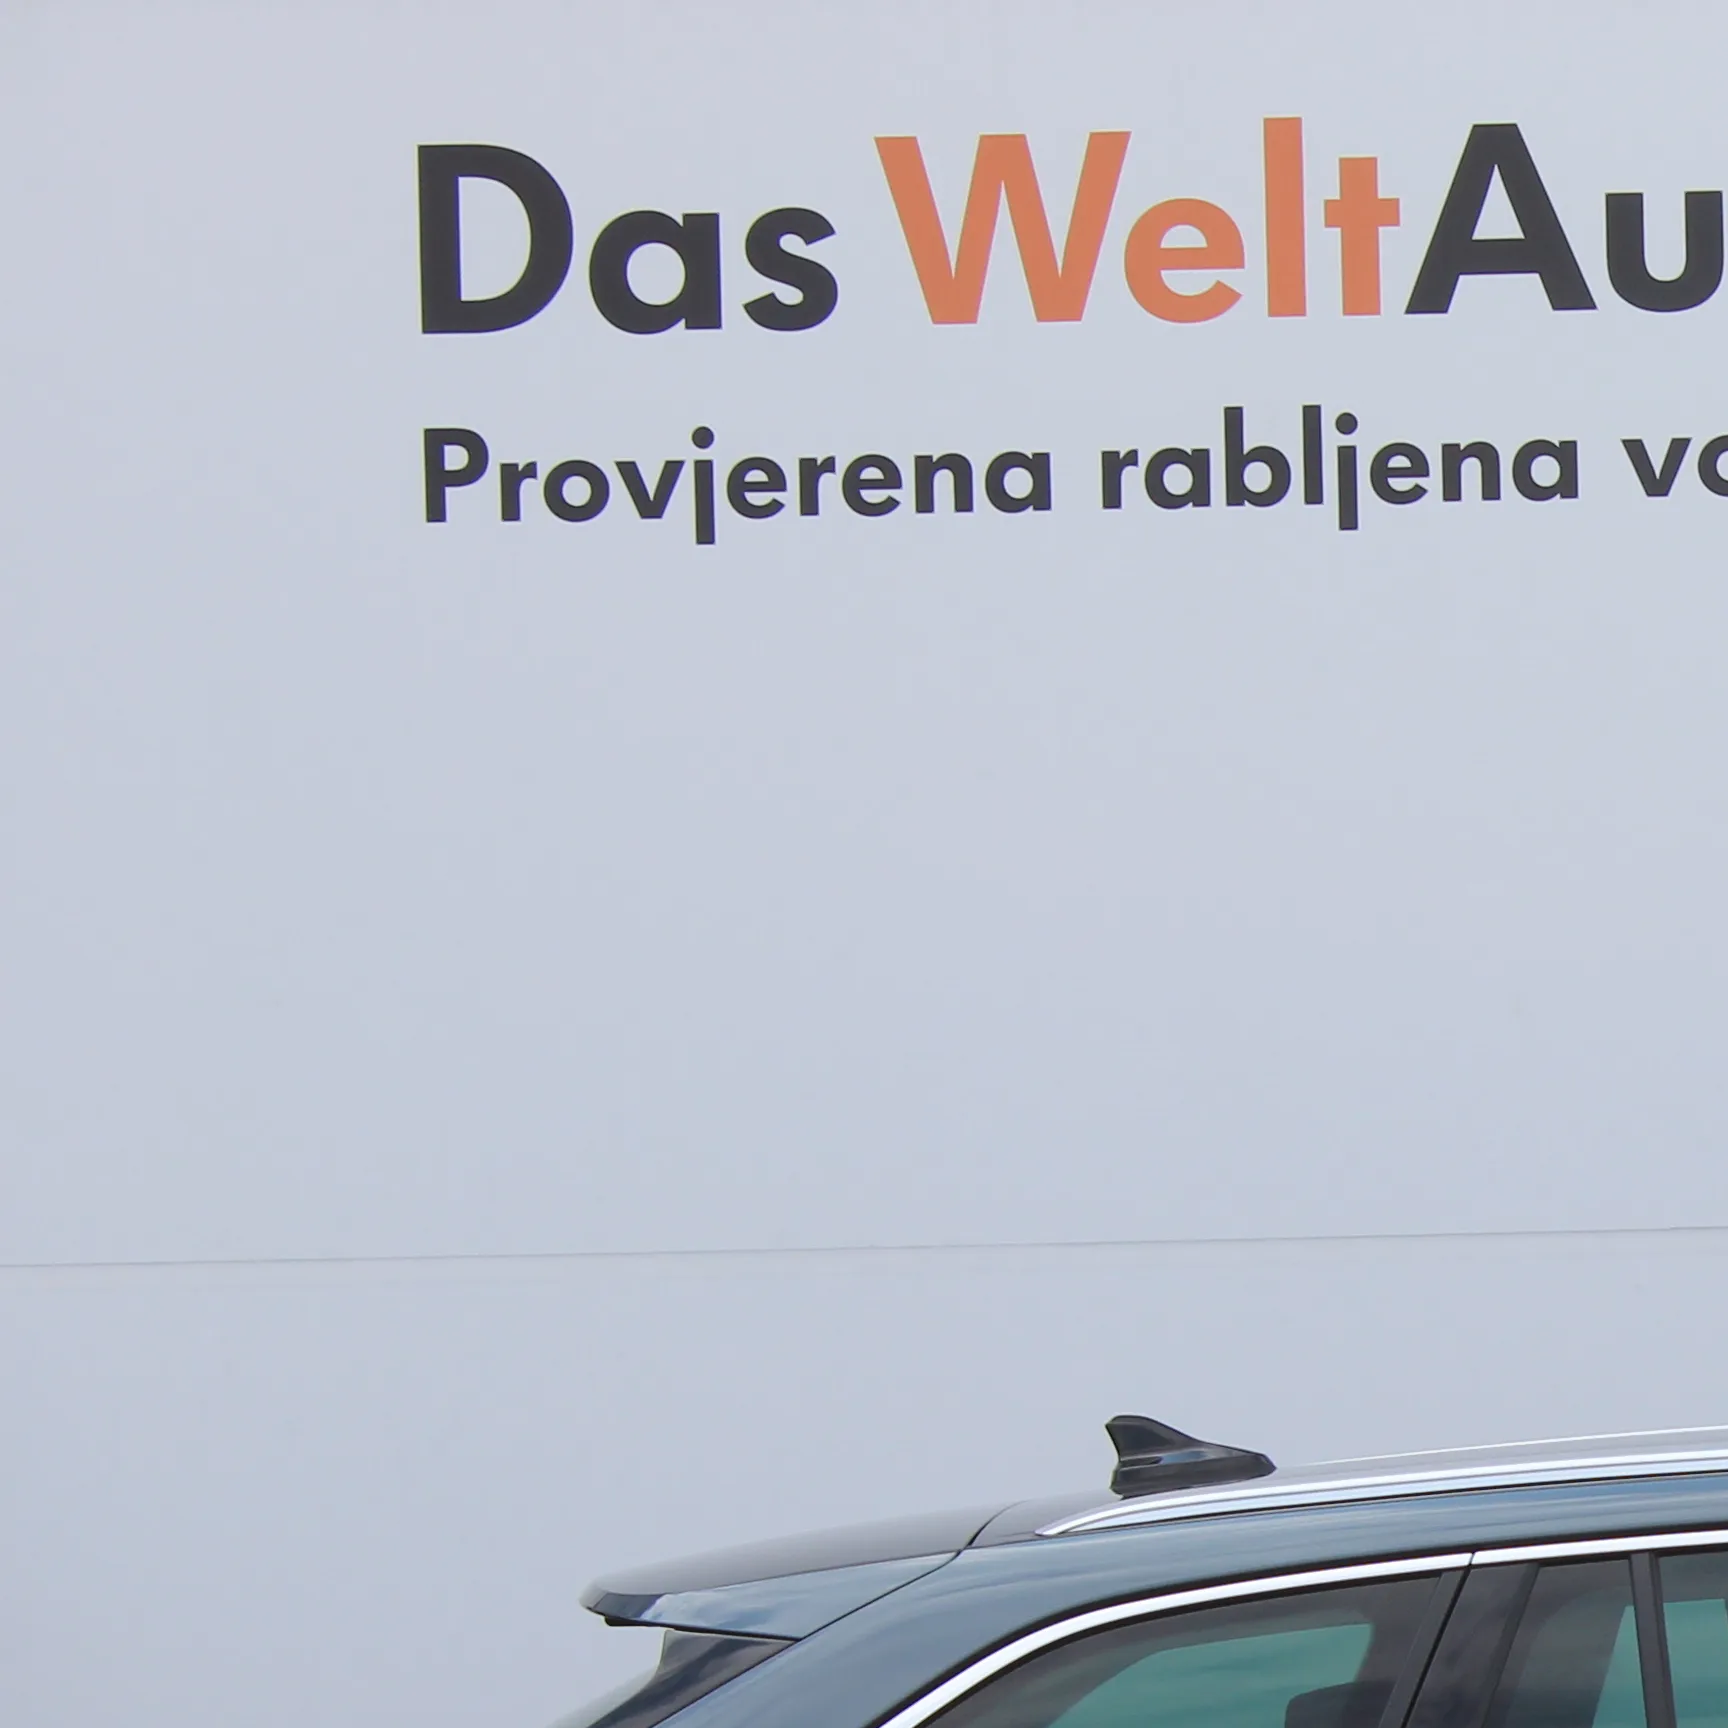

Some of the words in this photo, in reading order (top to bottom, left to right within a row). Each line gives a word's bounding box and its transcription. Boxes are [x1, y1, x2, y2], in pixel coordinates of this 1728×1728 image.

[418, 144, 838, 334] Das
[424, 426, 1051, 545] Provjerena
[1102, 405, 1578, 530] rabljena
